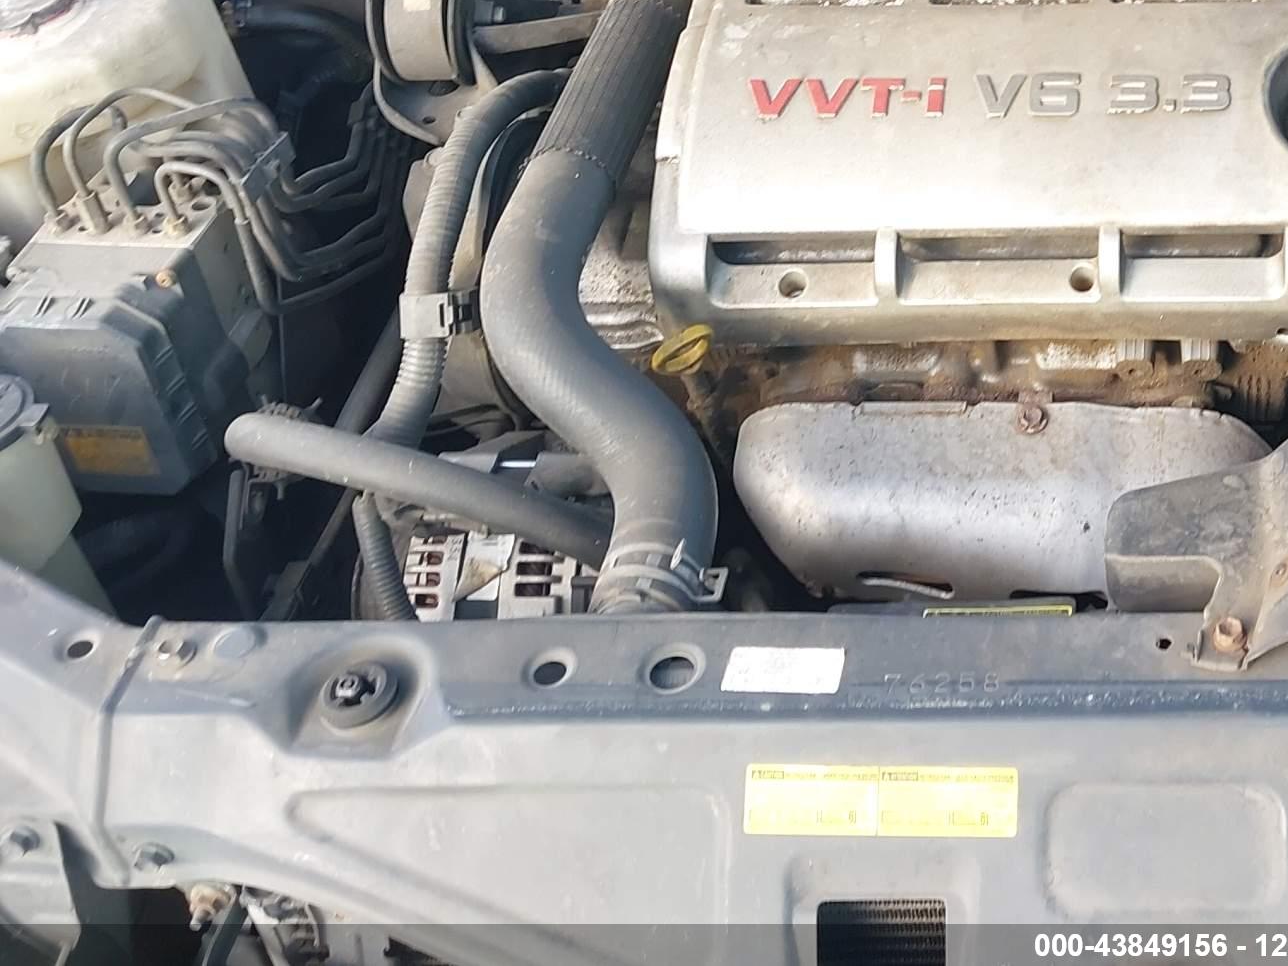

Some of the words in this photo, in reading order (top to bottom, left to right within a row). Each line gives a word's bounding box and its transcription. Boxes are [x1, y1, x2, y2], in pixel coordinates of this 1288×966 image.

[751, 76, 946, 118] VVT-i
[976, 72, 1082, 118] V6
[1106, 74, 1232, 114] 3.3
[883, 672, 1000, 695] 76258
